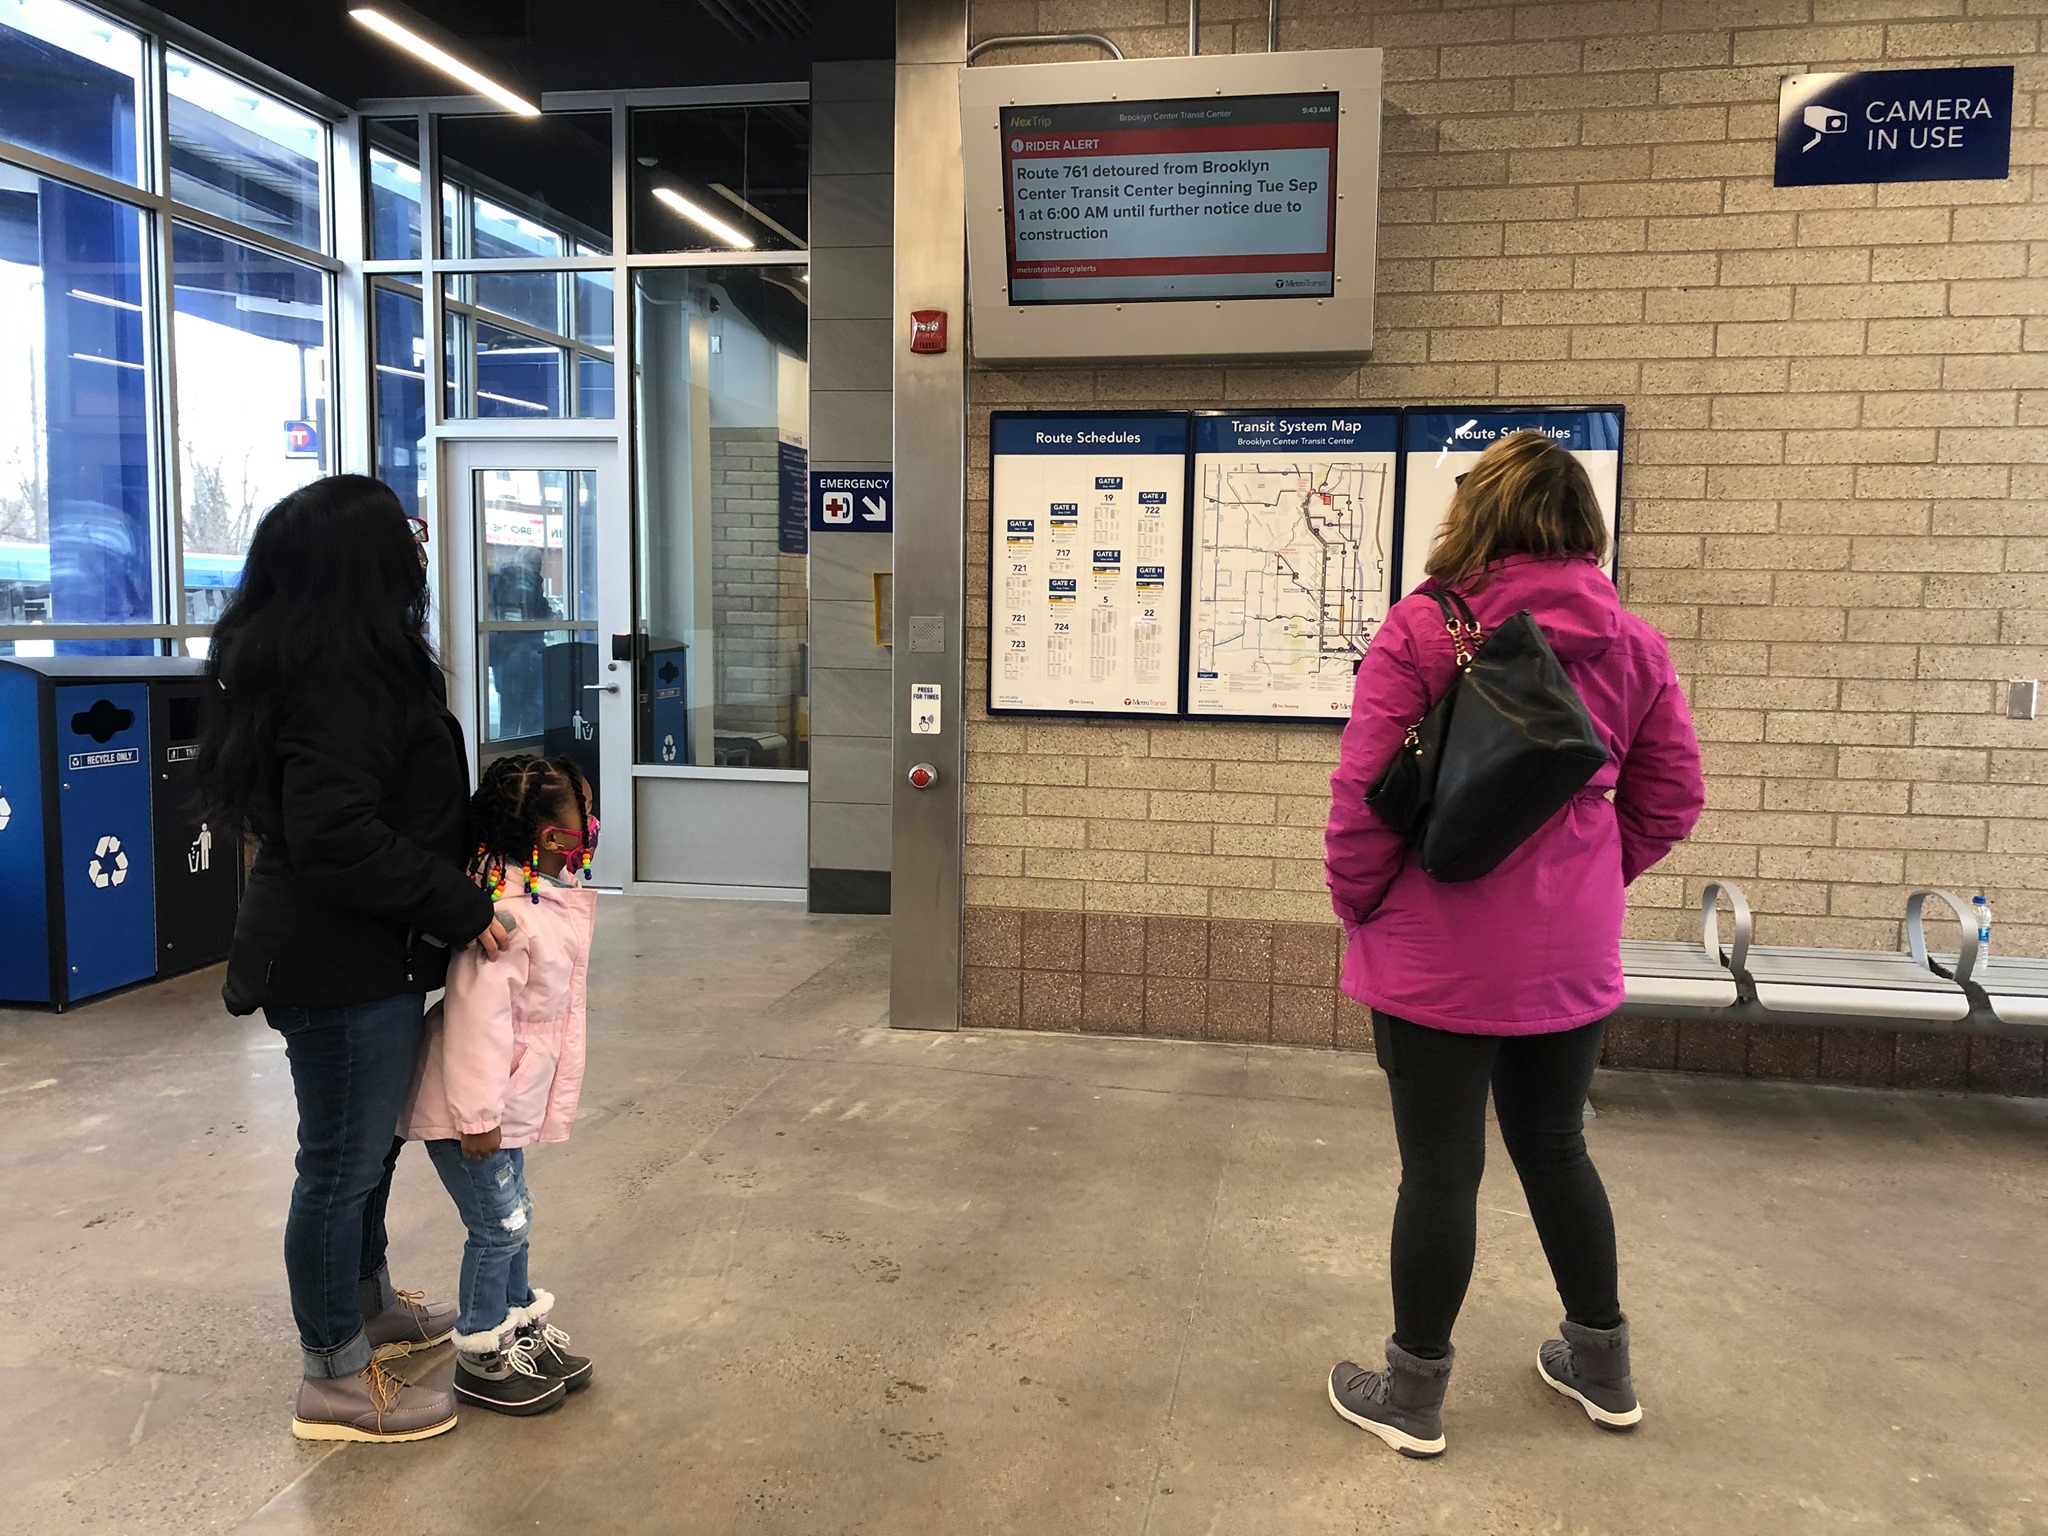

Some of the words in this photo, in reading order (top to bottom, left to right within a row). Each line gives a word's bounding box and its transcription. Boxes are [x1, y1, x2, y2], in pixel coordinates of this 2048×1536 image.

[1119, 113, 1151, 122] Brooklyn
[1153, 112, 1179, 120] Center
[1180, 111, 1205, 119] Transit
[1206, 110, 1232, 118] Center
[1865, 97, 1992, 123] CAMERA
[1010, 116, 1052, 128] NexTrip
[1867, 128, 1898, 151] IN
[1909, 126, 1965, 149] USE
[1025, 140, 1061, 151] RIDER
[1063, 139, 1100, 150] ALERT
[1017, 167, 1059, 180] Route
[1063, 165, 1088, 178] 761
[1092, 162, 1160, 177] detoured
[1163, 162, 1198, 175] from
[1203, 159, 1270, 175] Brooklyn
[1017, 187, 1066, 200] Center
[1070, 184, 1120, 199] Transit
[1123, 183, 1174, 197] Center
[1178, 180, 1252, 198] beginning
[1257, 180, 1284, 192] Tue
[1288, 179, 1318, 193] Sep
[1018, 208, 1025, 220] 1
[1029, 208, 1043, 220] at
[1047, 206, 1080, 220] 6:00
[1084, 206, 1109, 218] AM
[1113, 204, 1145, 218] until
[1149, 203, 1200, 217] further
[1204, 201, 1250, 215] notice
[1254, 200, 1283, 213] due
[1286, 200, 1302, 212] to
[1019, 226, 1109, 241] construction
[1016, 265, 1097, 274] metrotransit.org/alerts
[1231, 420, 1275, 432] Transit
[1279, 420, 1327, 435] System
[1331, 420, 1362, 434] Map
[1036, 431, 1073, 444] Route
[1077, 431, 1141, 443] Schedules
[1237, 438, 1271, 447] Brooklyn
[1272, 438, 1299, 446] Center
[1300, 437, 1326, 445] Transit
[1328, 437, 1355, 445] Center
[820, 479, 889, 489] EMERGENCY
[1056, 549, 1071, 557] 717
[1012, 614, 1026, 622] 721
[87, 754, 115, 764] RECYCLE
[116, 752, 132, 762] ONLY
